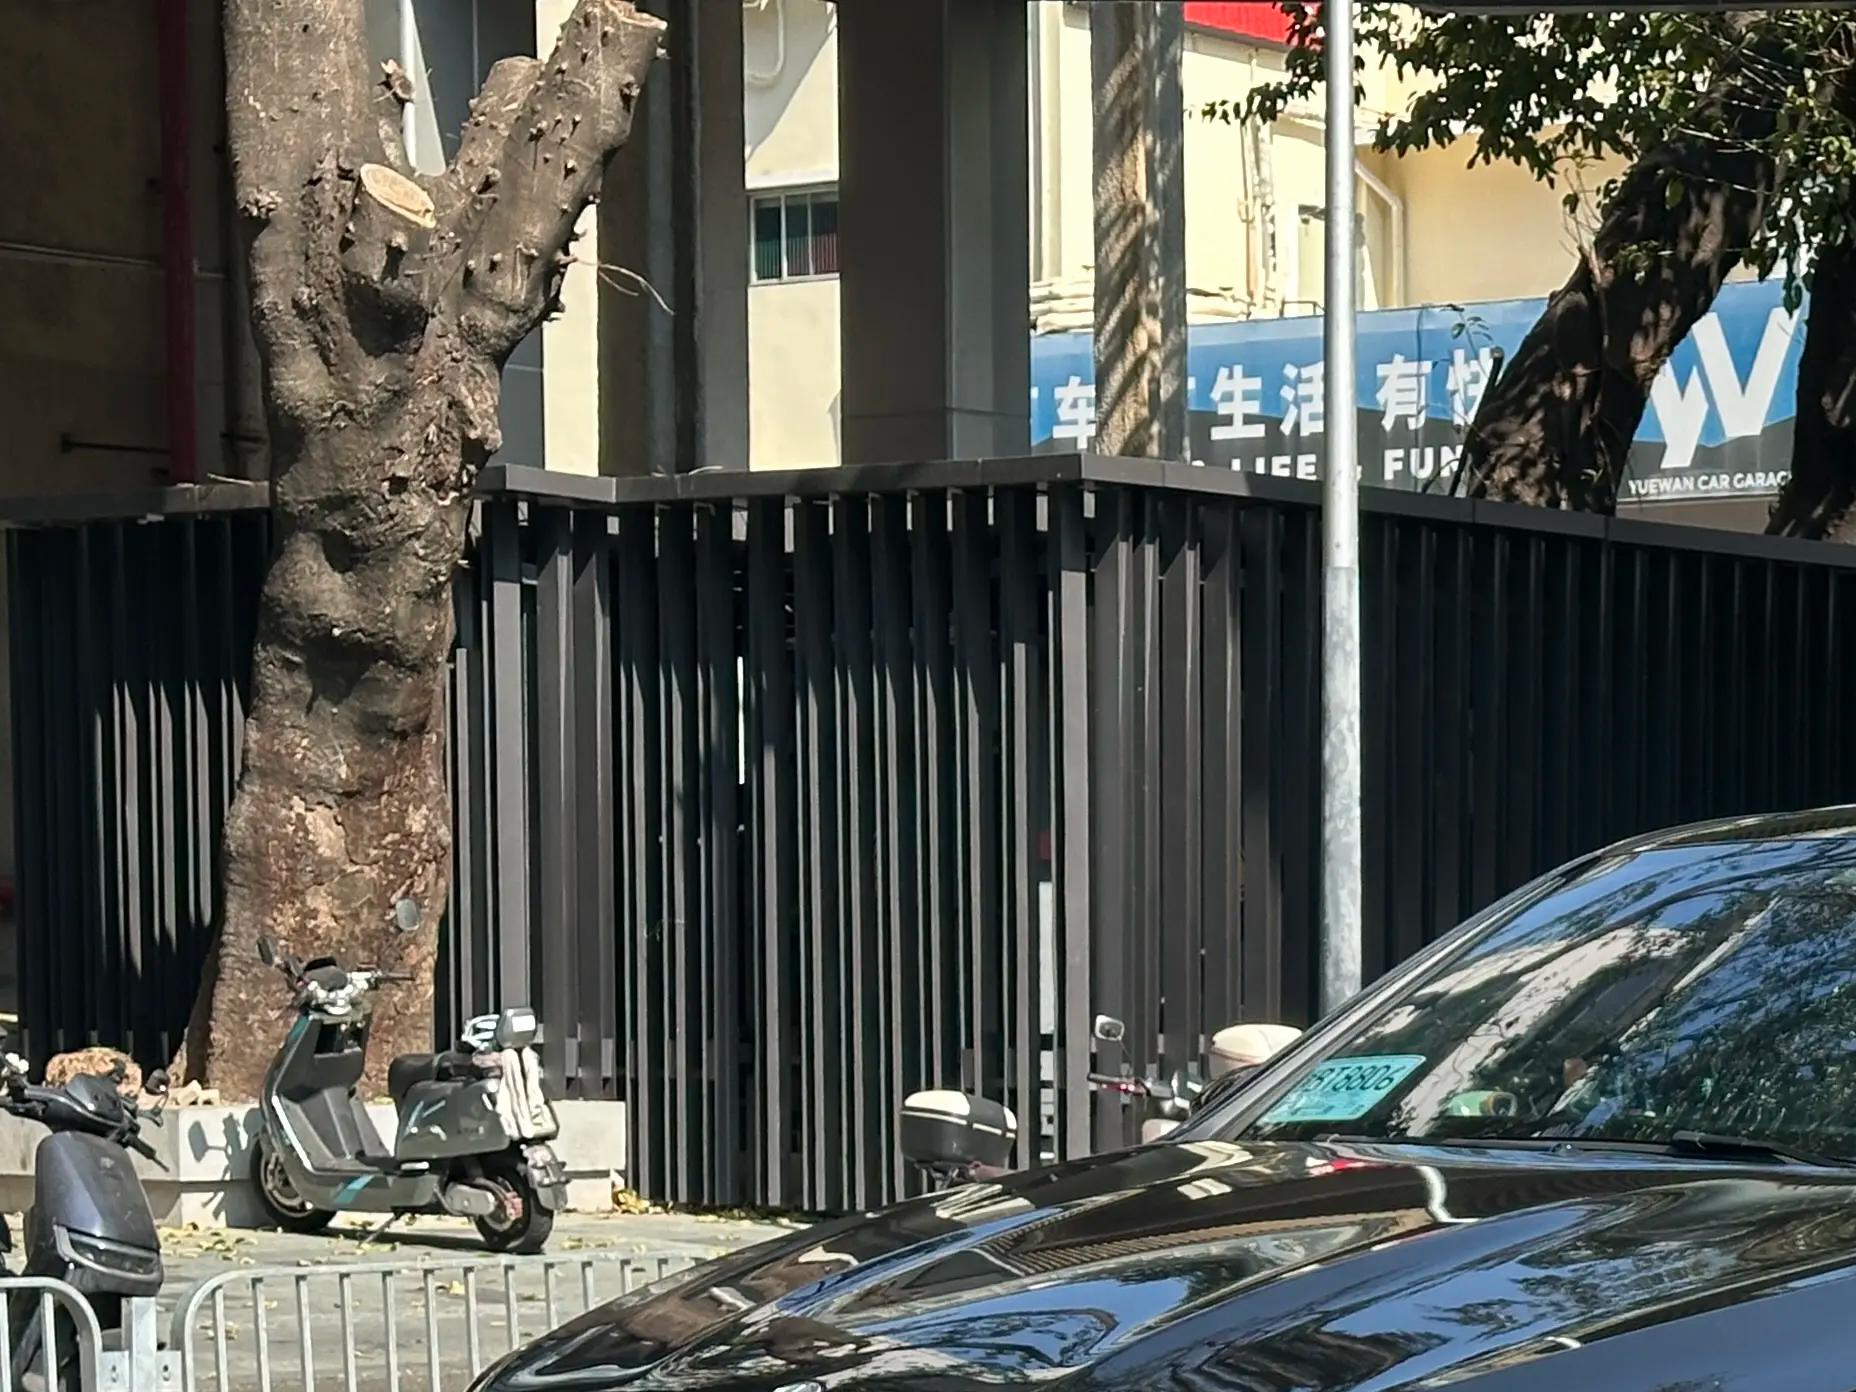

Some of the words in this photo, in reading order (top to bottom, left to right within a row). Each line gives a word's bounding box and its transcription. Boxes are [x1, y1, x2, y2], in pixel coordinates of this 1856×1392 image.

[1628, 475, 1695, 496] YUEWAN
[1697, 473, 1731, 490] CAR
[1732, 469, 1793, 488] GARAG
